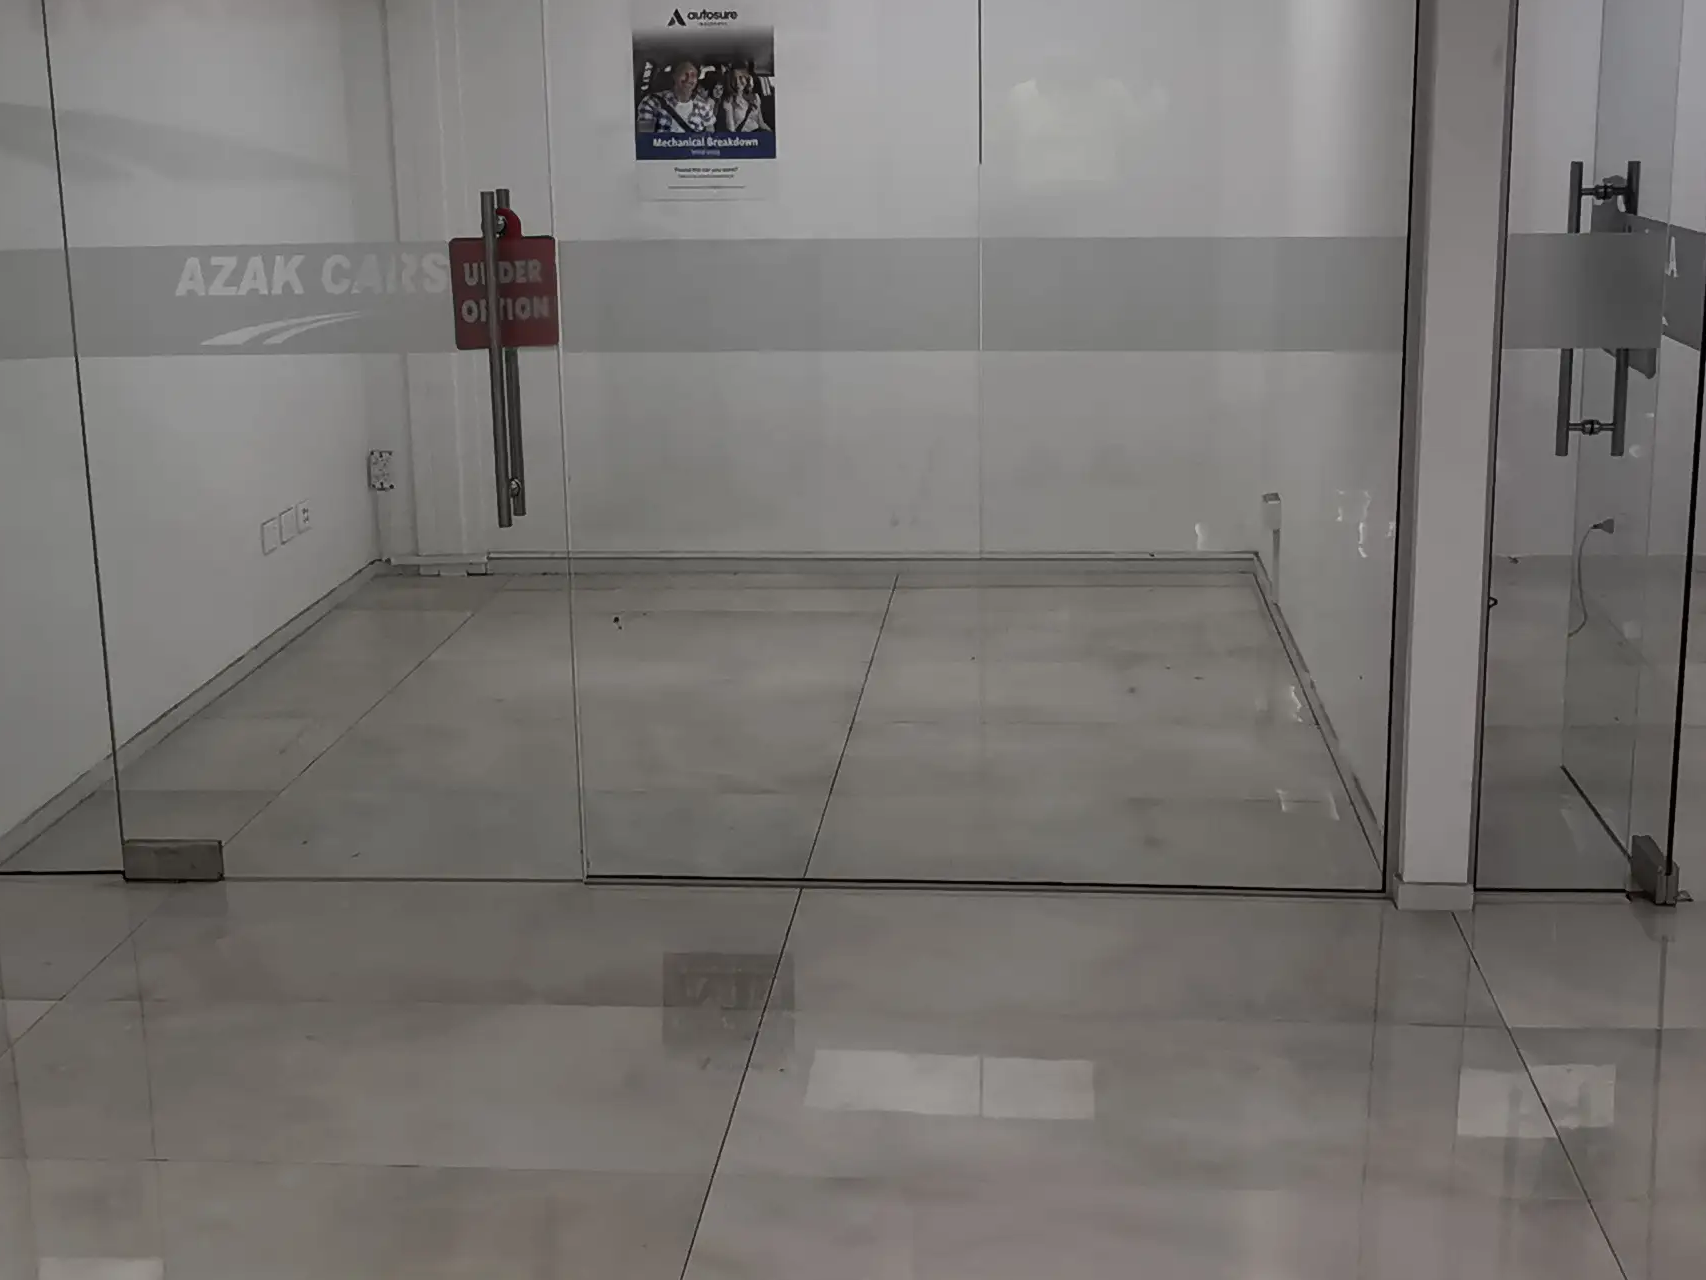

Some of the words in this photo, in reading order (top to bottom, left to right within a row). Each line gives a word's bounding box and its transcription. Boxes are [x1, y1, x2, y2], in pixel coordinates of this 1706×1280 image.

[652, 137, 705, 147] Mechanical
[706, 136, 759, 147] Breakdown
[175, 254, 306, 297] AZAK
[321, 252, 449, 295] CARS
